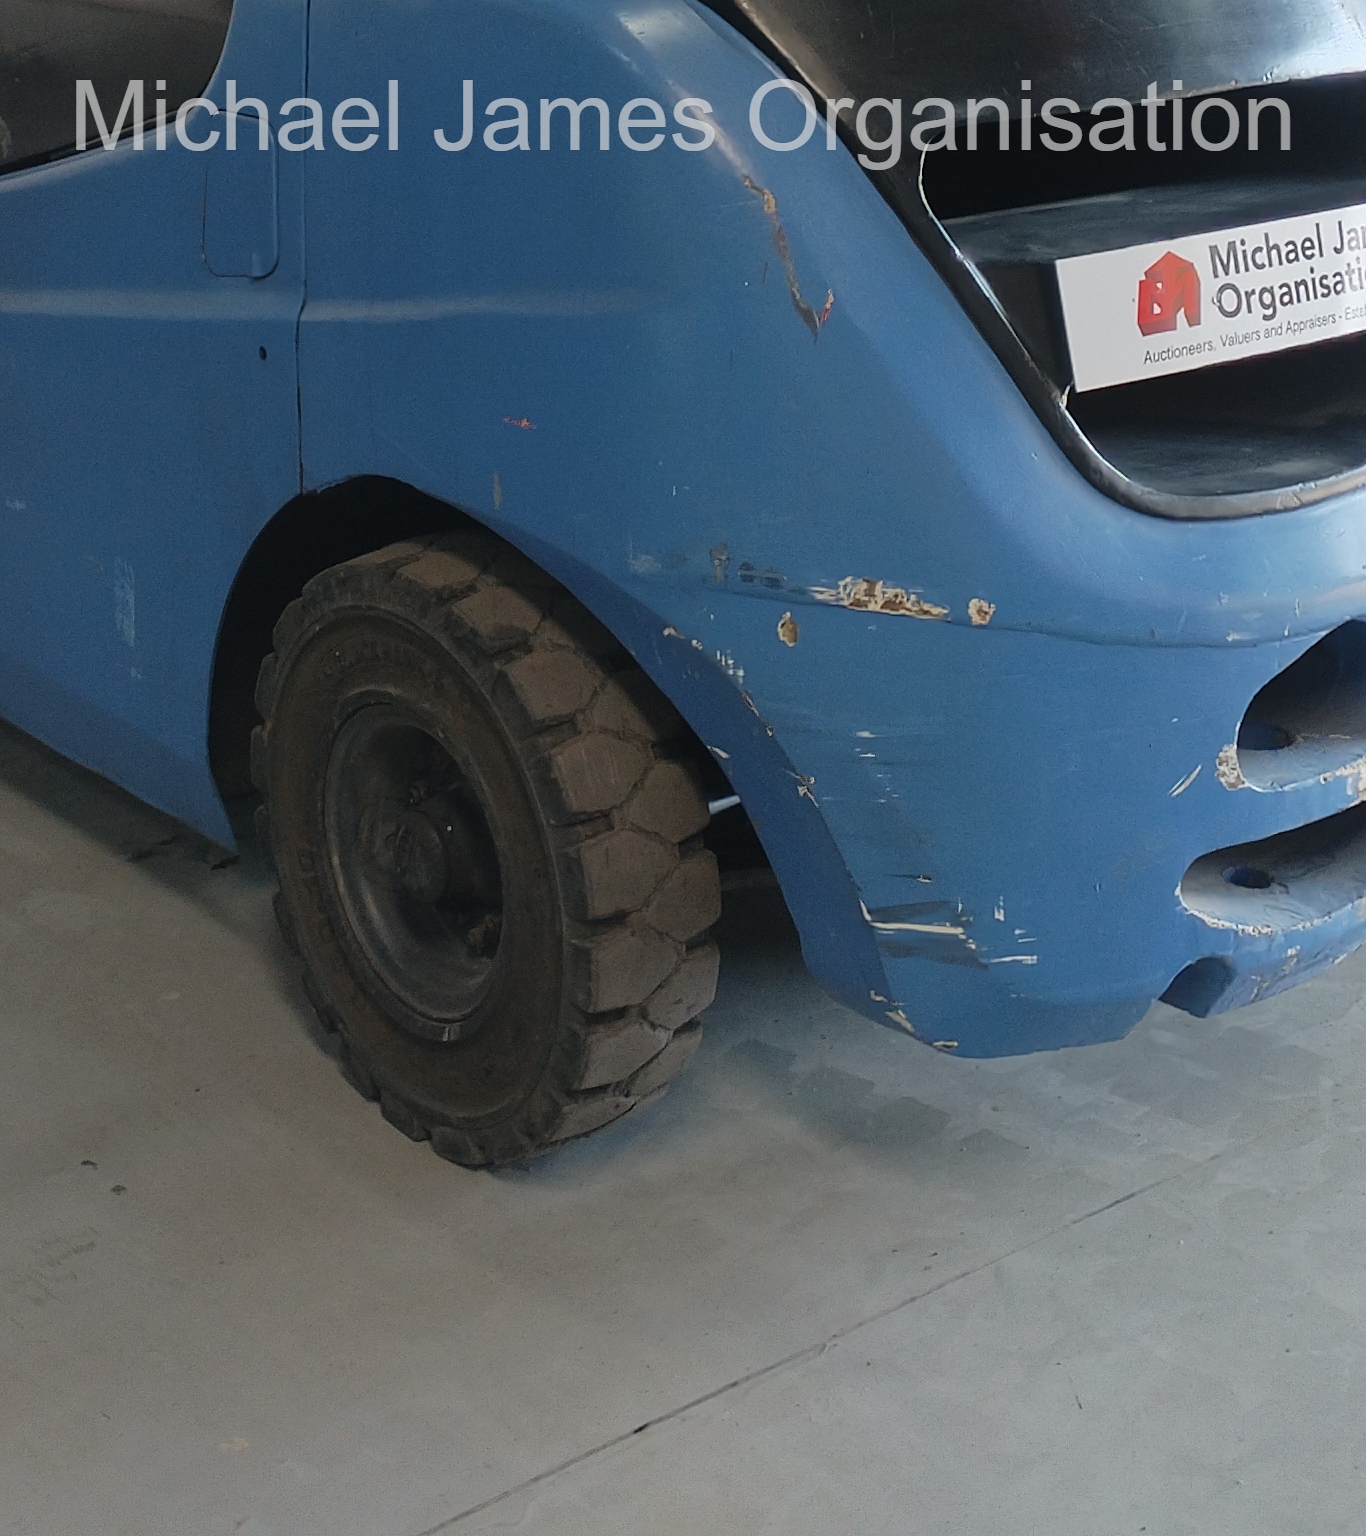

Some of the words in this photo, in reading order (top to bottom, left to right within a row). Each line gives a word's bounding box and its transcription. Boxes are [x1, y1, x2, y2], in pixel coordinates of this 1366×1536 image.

[1208, 222, 1324, 278] Michael
[1143, 338, 1217, 364] Auctioneers,
[1220, 329, 1261, 347] Valuers
[1263, 324, 1284, 339] and
[1286, 315, 1337, 336] Appraisers
